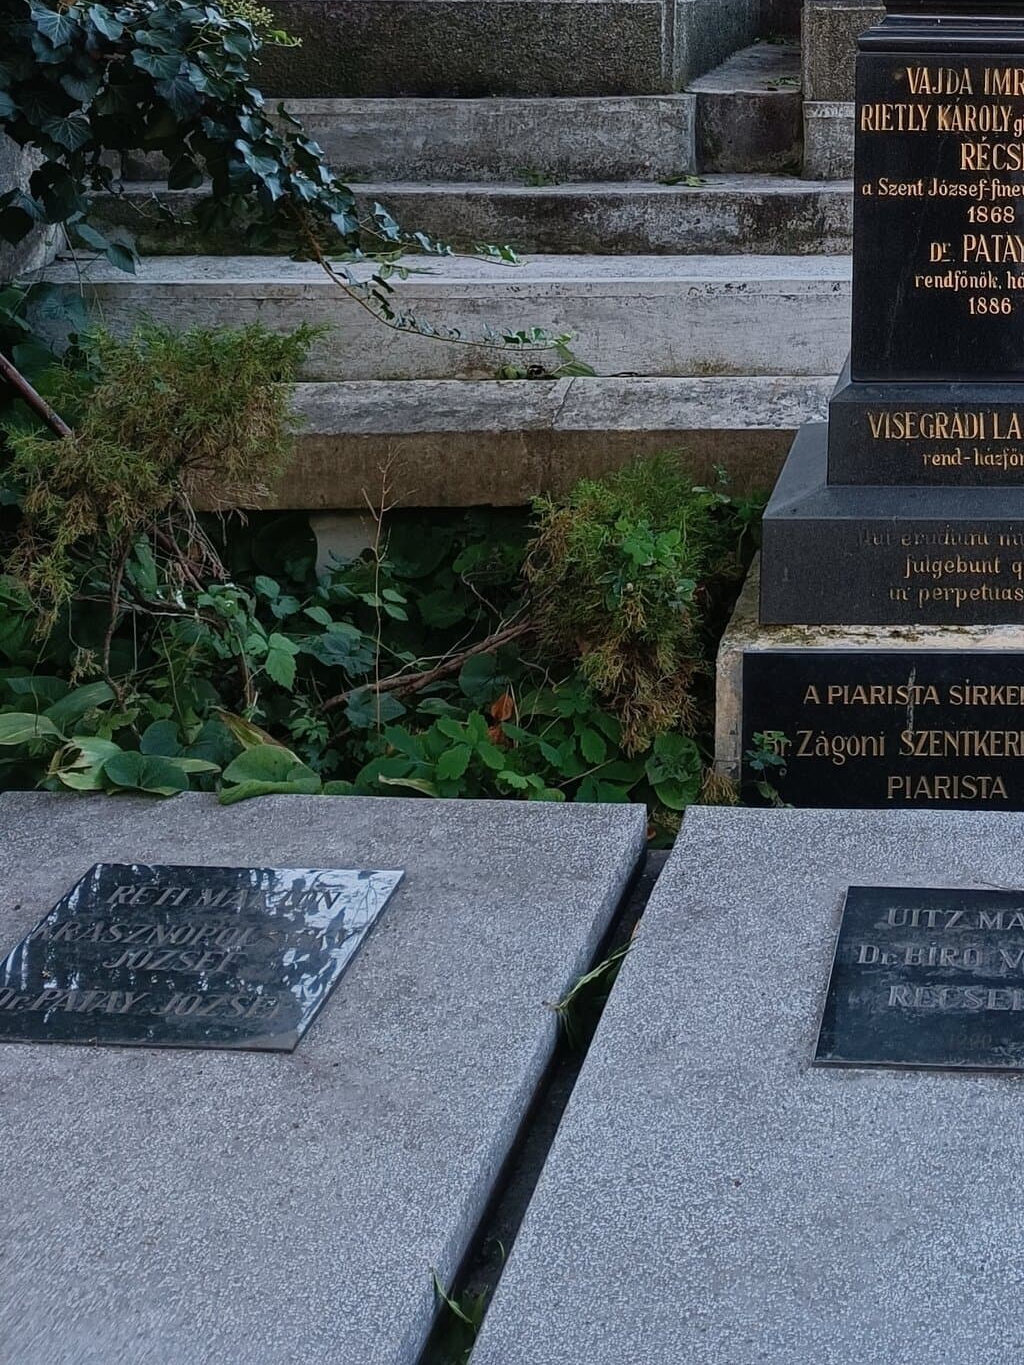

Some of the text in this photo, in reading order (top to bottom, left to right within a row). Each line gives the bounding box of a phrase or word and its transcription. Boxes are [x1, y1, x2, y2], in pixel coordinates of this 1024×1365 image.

[906, 67, 973, 95] VAJDA
[861, 104, 931, 131] RIETLY
[937, 97, 1012, 132] KÁROLY
[862, 184, 873, 196] a
[878, 177, 924, 196] Szent
[967, 206, 1015, 223] 1868
[969, 297, 1012, 315] 1886
[904, 554, 1001, 579] fulgebunt
[919, 583, 1024, 609] perpetuas
[803, 685, 820, 705] A
[828, 685, 940, 706] PIARISTA
[797, 730, 885, 766] Zágoni
[887, 776, 1008, 799] PIARISTA
[888, 907, 966, 930] UITZ
